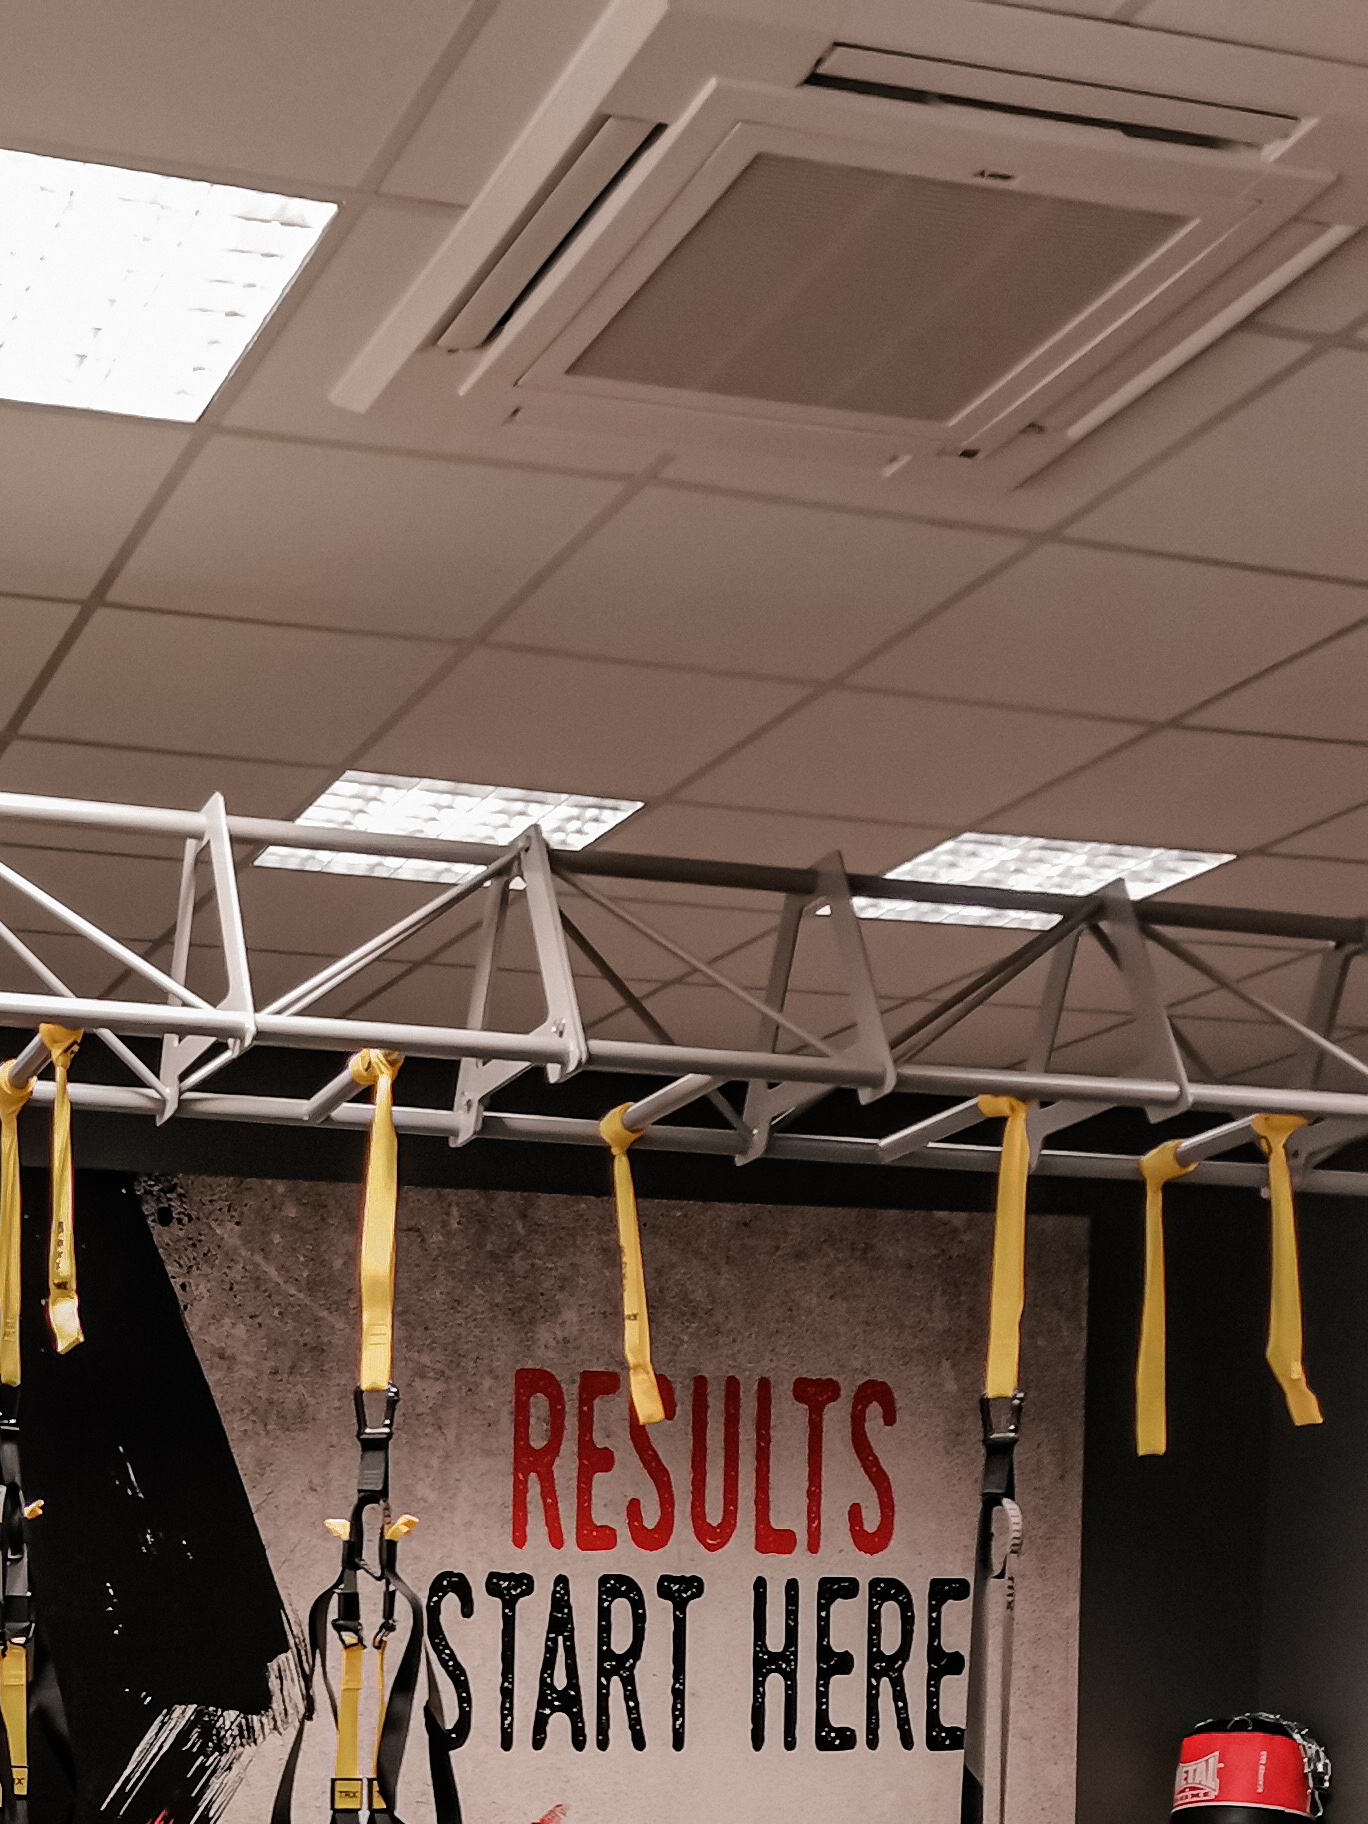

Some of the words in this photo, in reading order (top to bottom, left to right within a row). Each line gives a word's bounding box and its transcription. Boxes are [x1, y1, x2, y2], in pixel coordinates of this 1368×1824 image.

[511, 1368, 896, 1556] RESULTS
[425, 1571, 705, 1752] START
[750, 1576, 971, 1752] HERE
